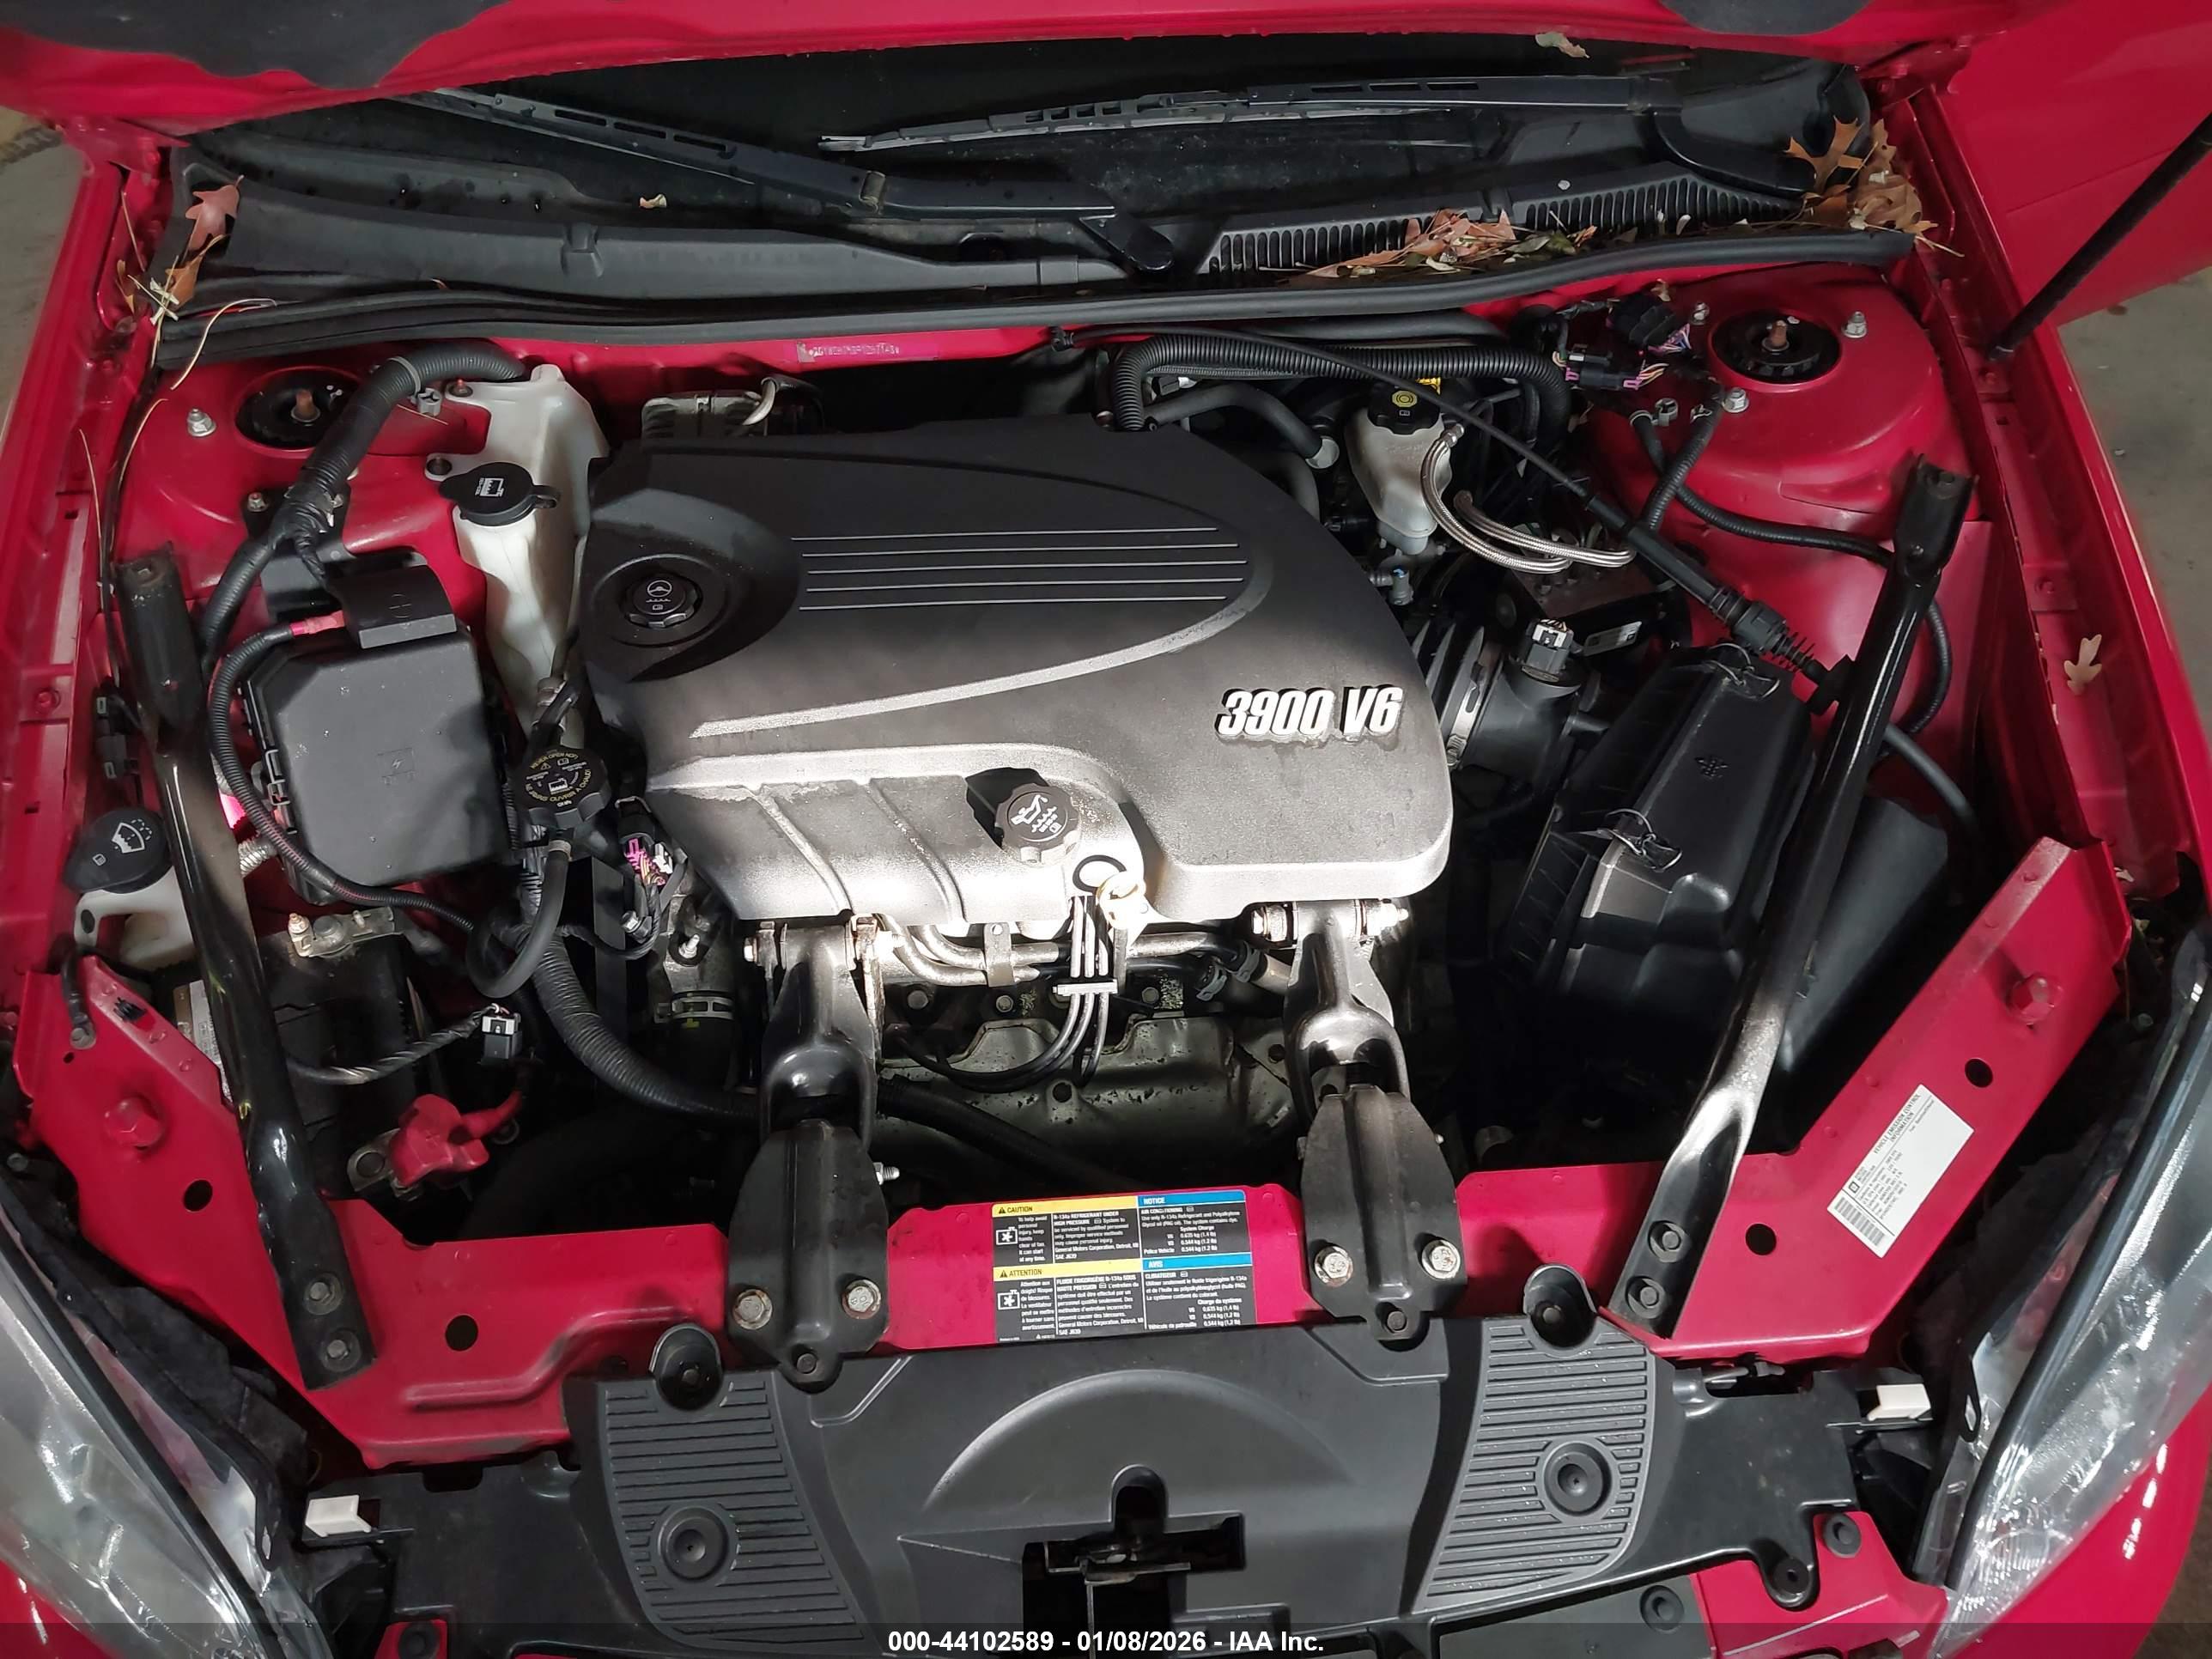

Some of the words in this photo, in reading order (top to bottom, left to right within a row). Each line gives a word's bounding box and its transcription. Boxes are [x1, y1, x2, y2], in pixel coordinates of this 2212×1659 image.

[1214, 689, 1334, 736] 3900
[1340, 684, 1403, 734] V6
[1873, 1134, 1890, 1154] VEHICLE
[1887, 1114, 1905, 1135] EMISSION
[1902, 1094, 1921, 1115] CONTROL
[1889, 1112, 1914, 1142] INFORMATION
